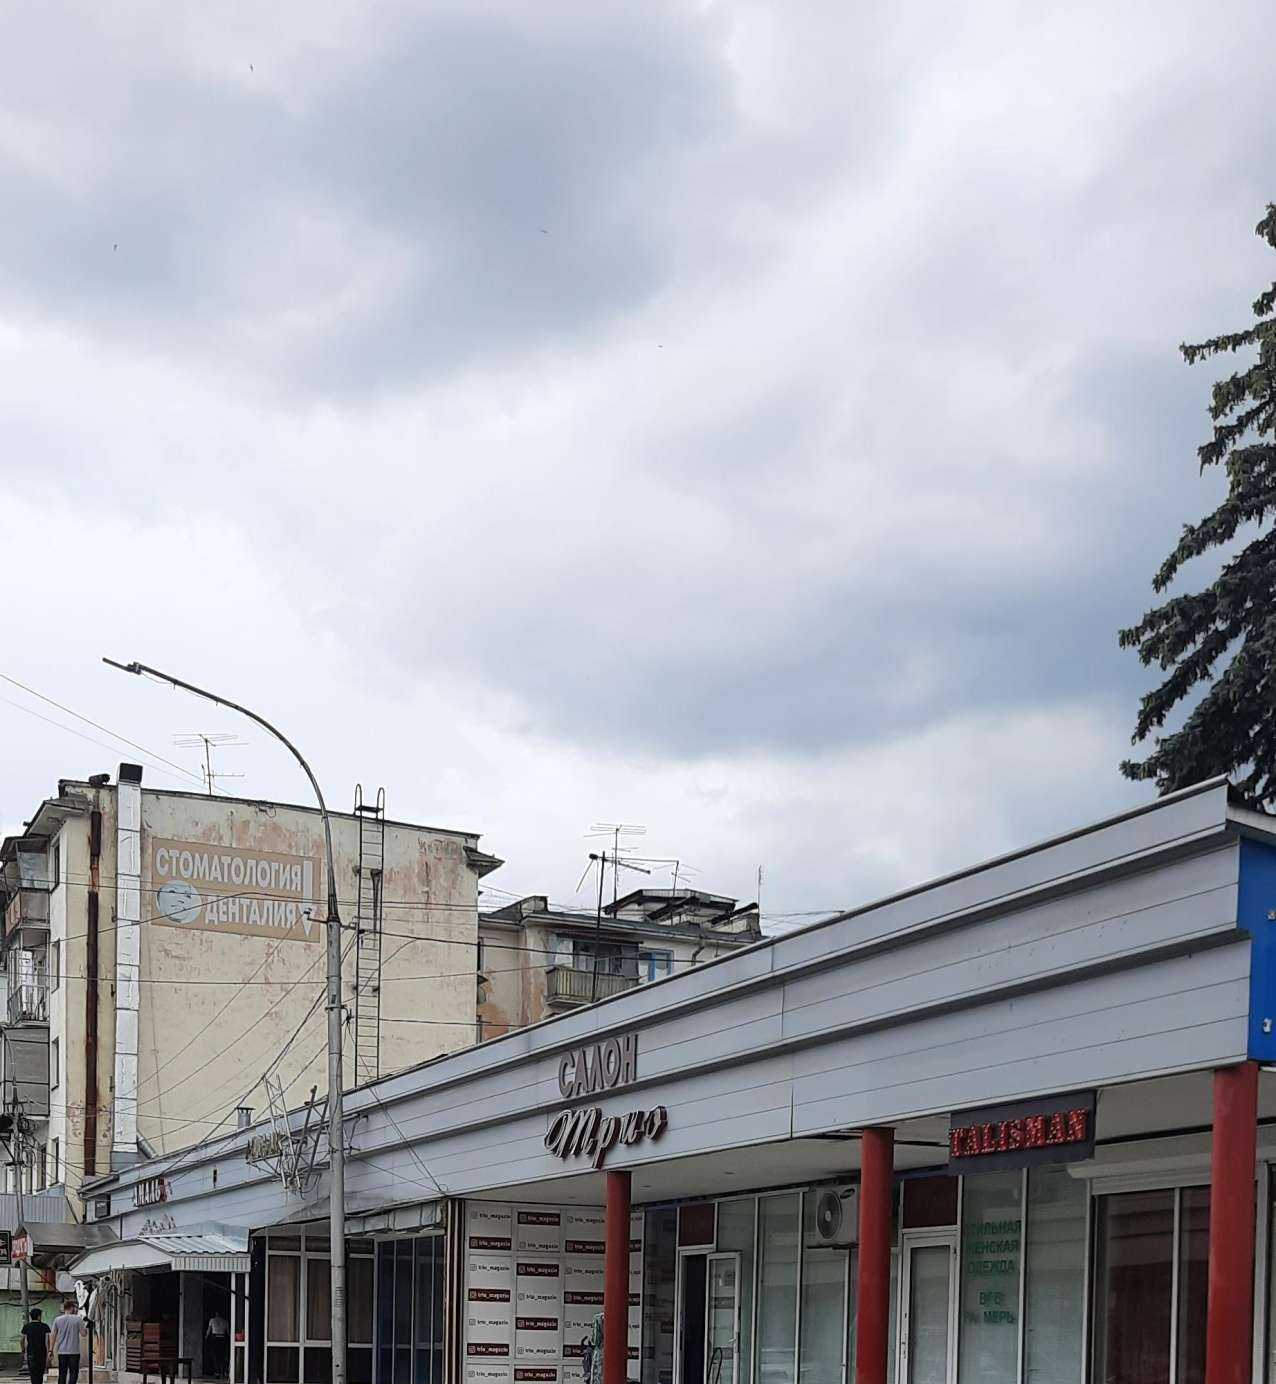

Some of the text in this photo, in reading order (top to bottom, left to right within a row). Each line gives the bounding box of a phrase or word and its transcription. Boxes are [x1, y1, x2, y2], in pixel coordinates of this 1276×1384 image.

[156, 848, 301, 892] СТОМАТОЛОГИЯ
[205, 896, 297, 929] ДЕНТАЛИЯ
[559, 1033, 638, 1098] САЛОН
[949, 1108, 1088, 1157] TALISMAN
